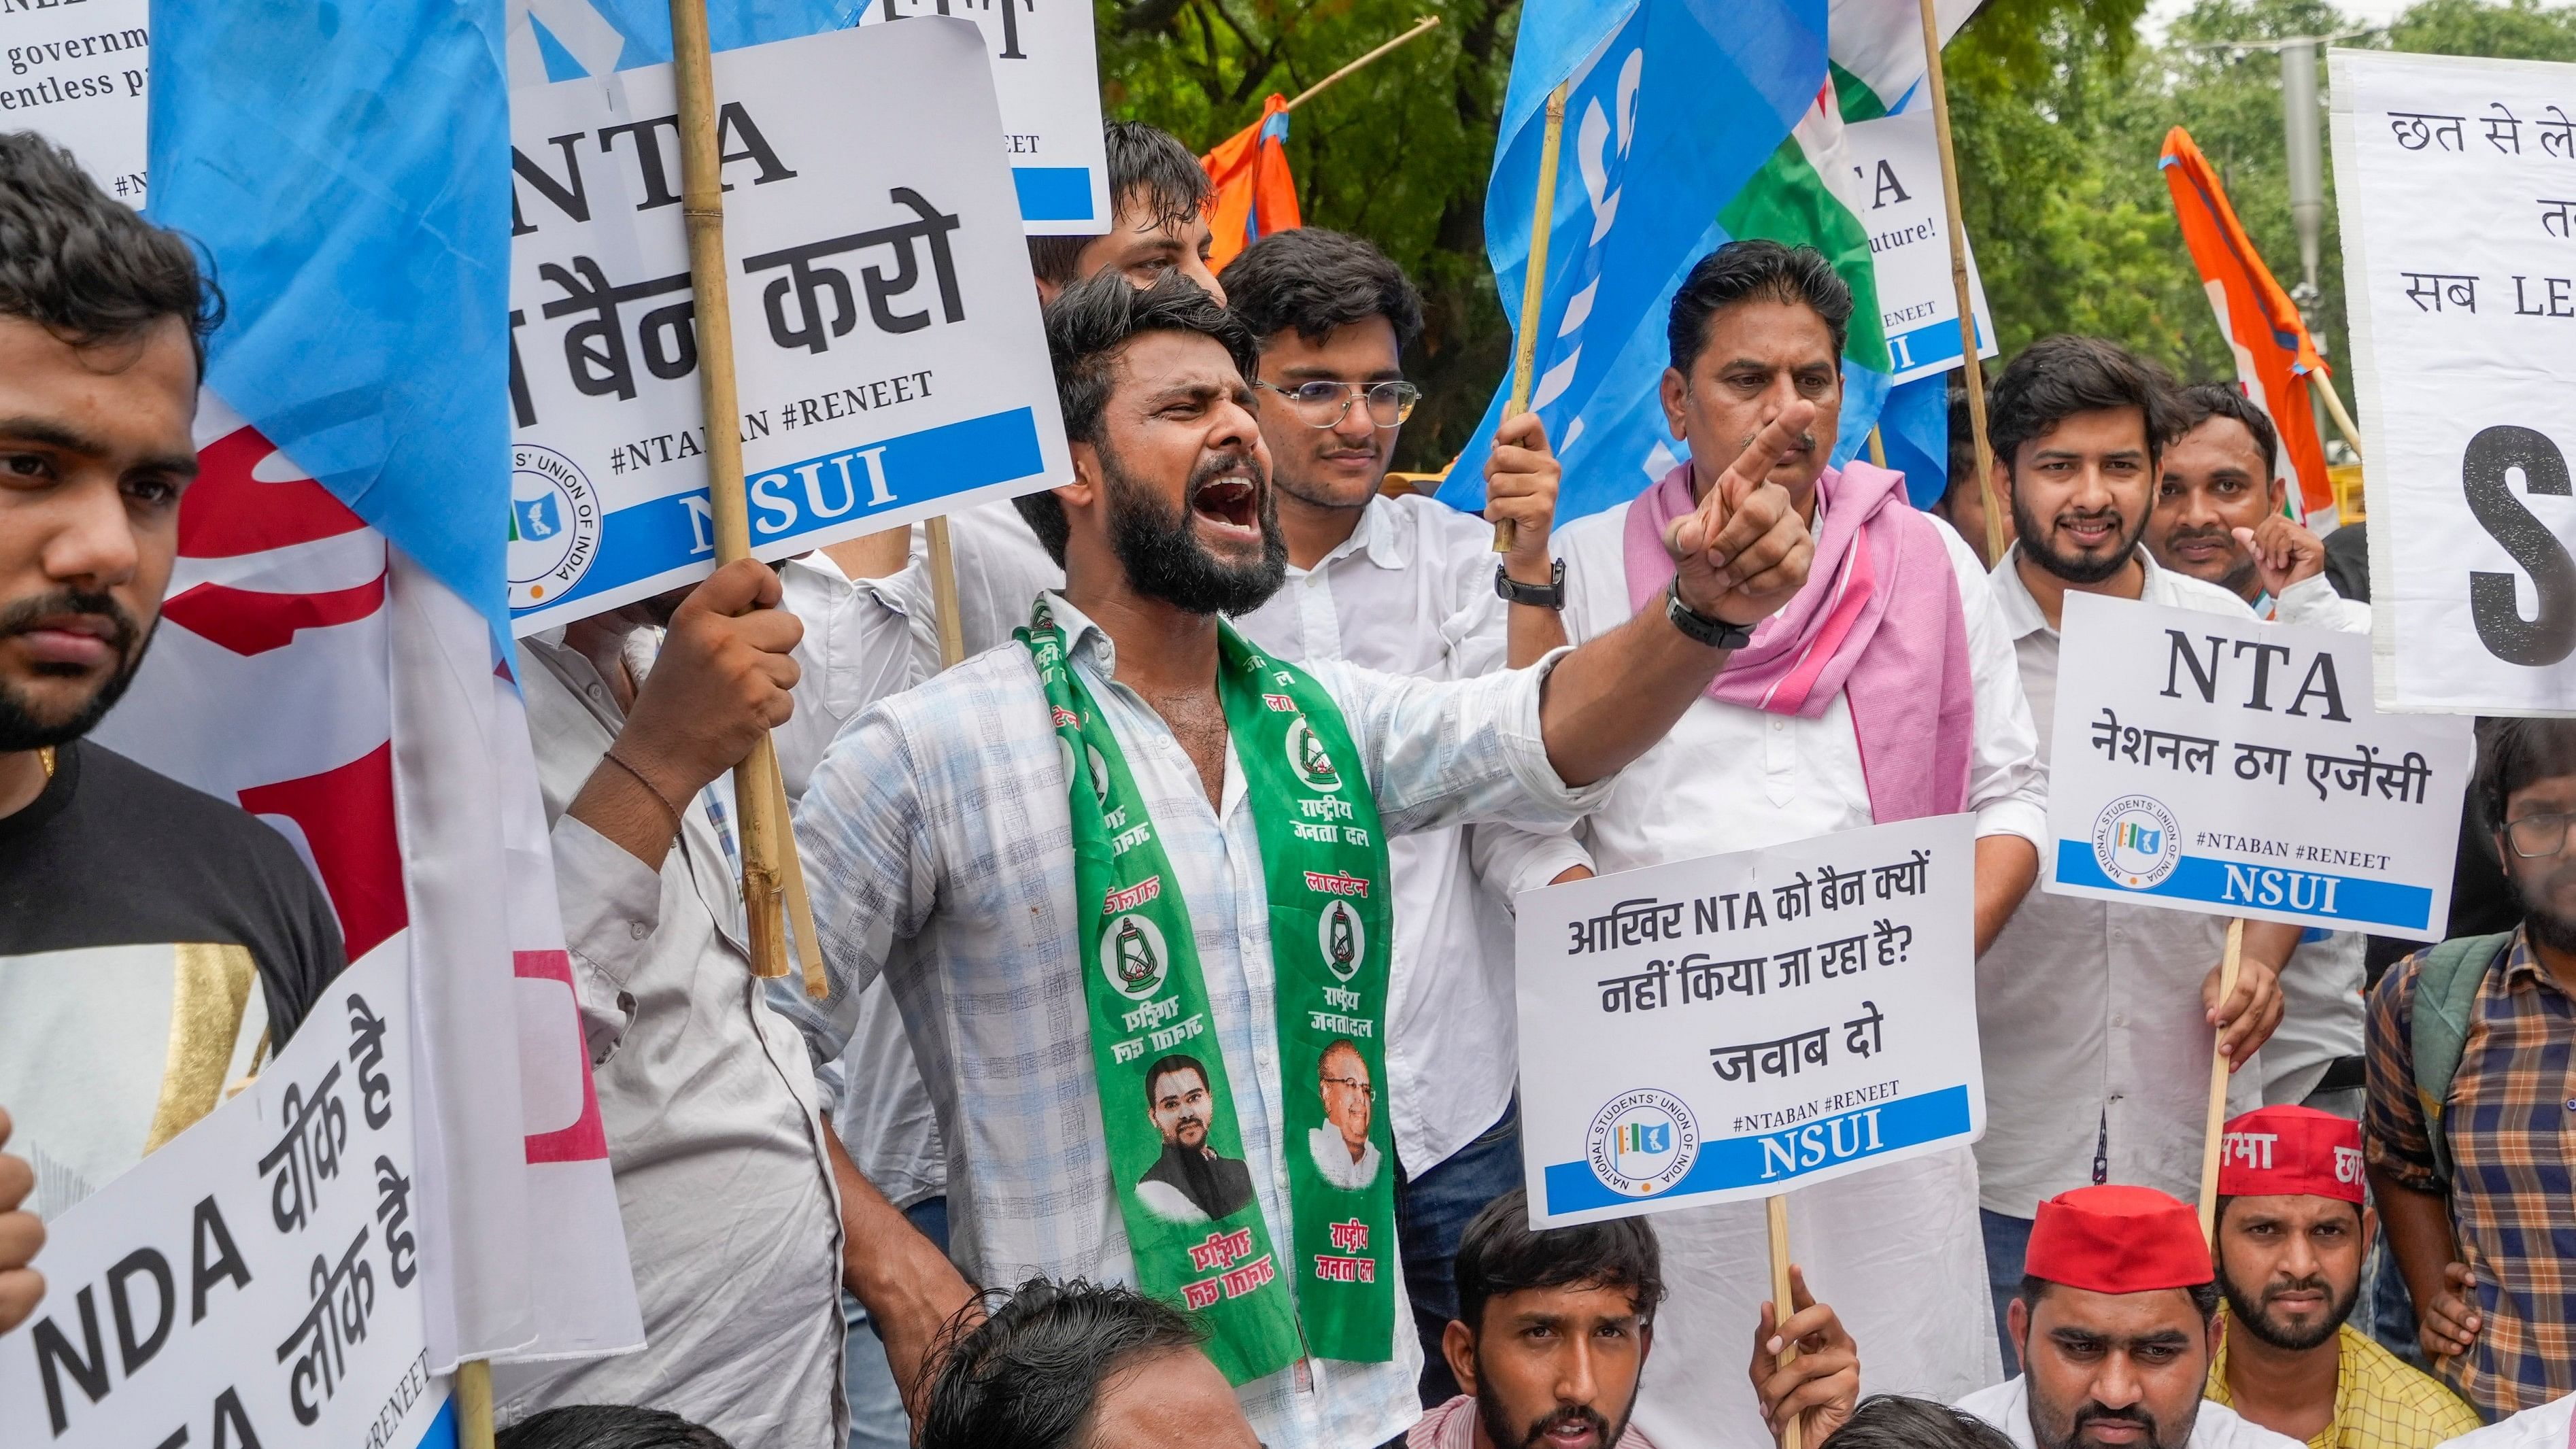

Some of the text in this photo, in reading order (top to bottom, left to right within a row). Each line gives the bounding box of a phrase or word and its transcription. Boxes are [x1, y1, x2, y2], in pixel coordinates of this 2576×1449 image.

[2387, 111, 2467, 152] छत
[2479, 101, 2524, 156] से
[511, 101, 798, 237] NTA
[742, 186, 966, 355] करो
[2400, 272, 2480, 314] सब
[781, 370, 934, 432] #RENEET
[538, 455, 593, 581] UNION OF INDIA
[2159, 628, 2352, 723] NTA
[2090, 707, 2433, 804] नेशनल ठग एजेंसी
[1289, 819, 1370, 847] जनता दल
[1297, 794, 1354, 821] राष्ट्रीय
[2156, 808, 2177, 841] UNION
[2097, 828, 2122, 879] NATIONAL
[2146, 861, 2173, 883] INDIA
[2169, 847, 2177, 861] OF
[2196, 831, 2391, 871] #NTABAN #RENEET
[1304, 870, 1369, 899] लालटेन
[1568, 849, 1931, 955] आखिर NTA को बैन क्यों
[2220, 864, 2341, 914] NSUI
[1597, 918, 1912, 1013] नहीं किया जा रहा है?
[1710, 1000, 1884, 1083] जवाब दो
[1661, 1097, 1691, 1130] UNION
[1733, 1079, 1900, 1133] #NTABAN #RENEET
[1592, 1138, 1630, 1191] NATIONAL
[1683, 1133, 1694, 1151] OF
[1757, 1108, 1884, 1180] NSUI
[1661, 1154, 1690, 1184] INDIA
[31, 1193, 253, 1440] NDA
[258, 1059, 348, 1235] वीक
[346, 992, 392, 1131] है
[1329, 1218, 1369, 1254] राष्ट्रीय
[275, 1154, 417, 1427] लीक है
[1315, 1255, 1375, 1283] जनता दल
